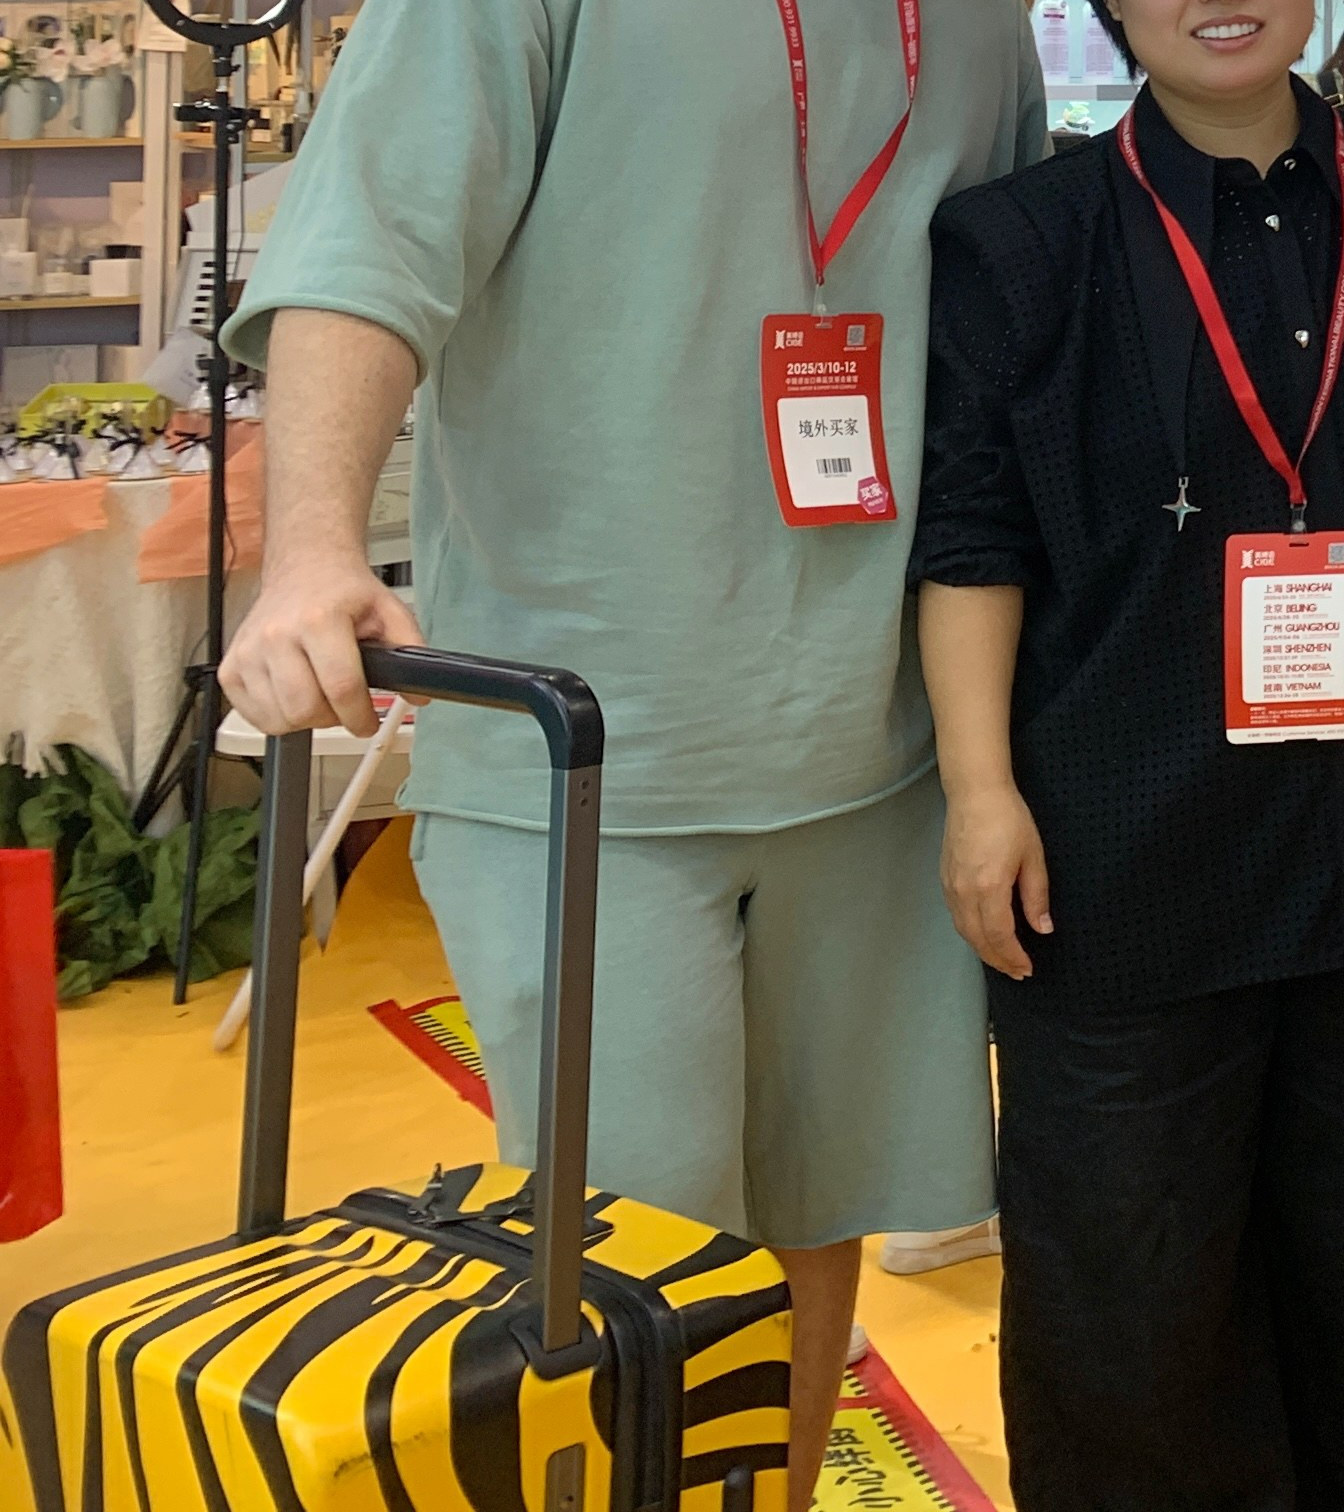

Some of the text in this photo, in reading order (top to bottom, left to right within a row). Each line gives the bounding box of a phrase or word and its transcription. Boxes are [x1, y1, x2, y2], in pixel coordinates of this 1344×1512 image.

[787, 361, 857, 376] 2025/3/10-12
[799, 418, 859, 438] 境外买家
[860, 483, 883, 500] 买家
[1286, 583, 1332, 593] SHANGHAI
[1264, 622, 1340, 633] 广州 GUANGZHOU
[1285, 643, 1331, 653] SHENZHEN
[1286, 663, 1331, 672] INDONESIA
[1286, 682, 1321, 691] VIETNAM
